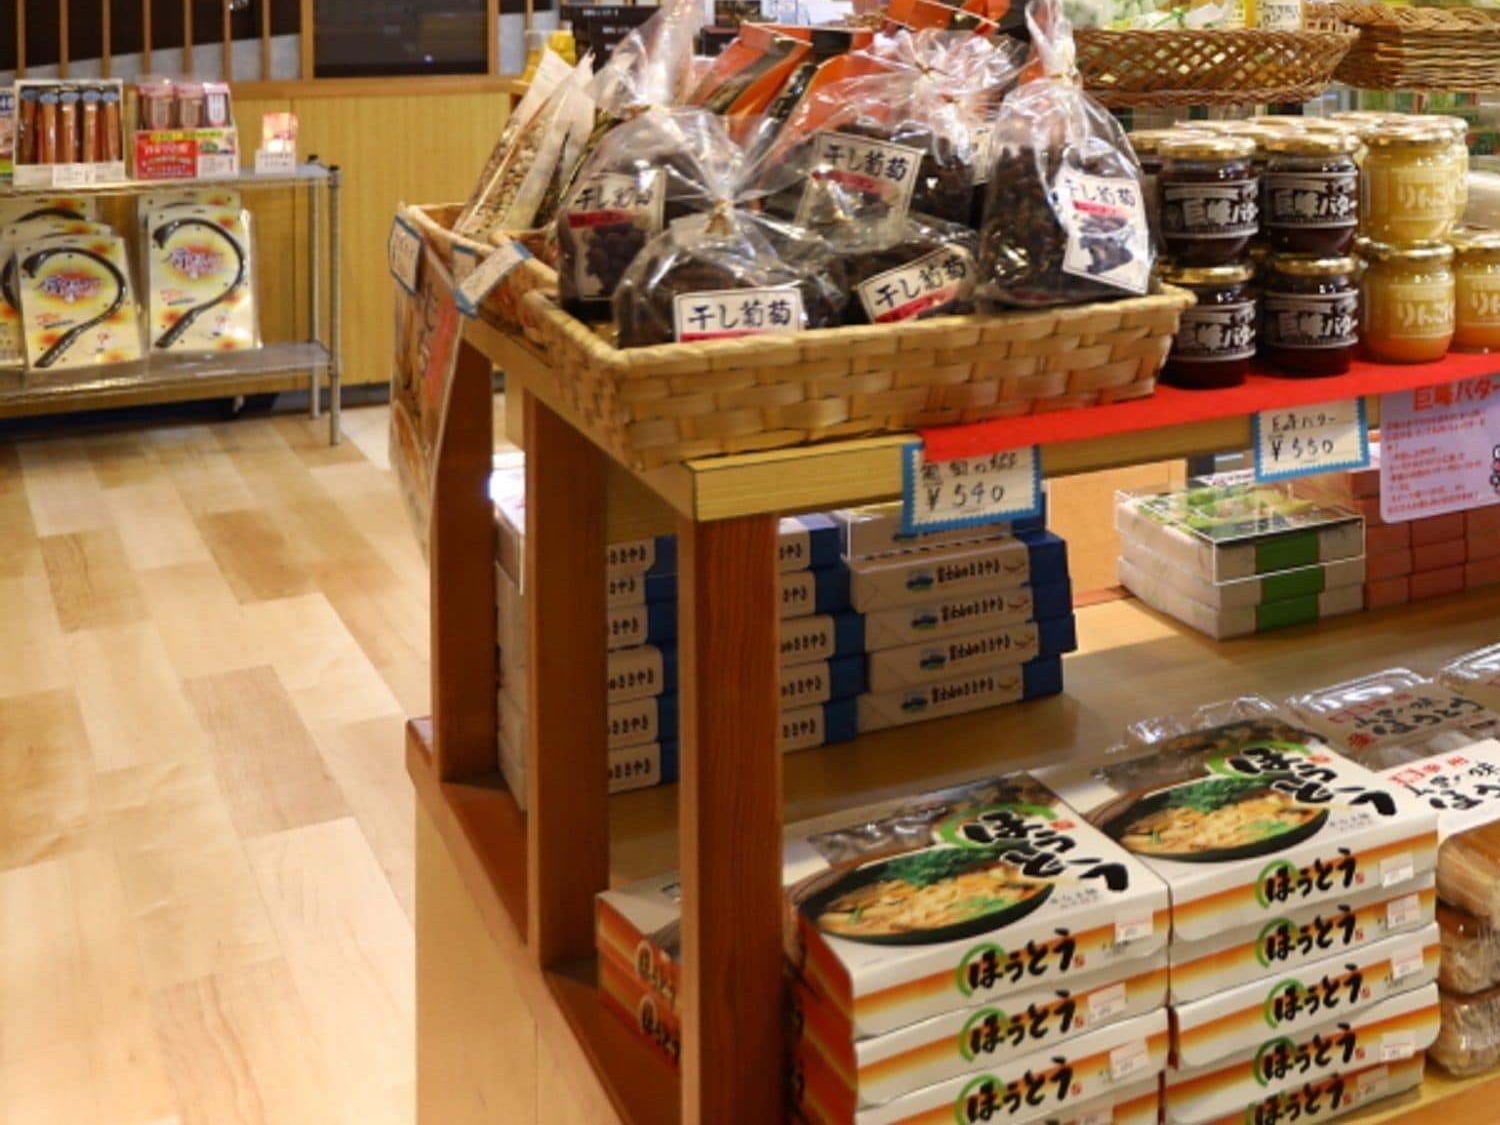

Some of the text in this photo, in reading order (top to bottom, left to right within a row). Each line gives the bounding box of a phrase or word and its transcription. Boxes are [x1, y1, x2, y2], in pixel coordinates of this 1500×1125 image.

[826, 144, 908, 182] 干し葡萄
[875, 257, 967, 309] 干し葡萄
[688, 299, 792, 332] 干し葡萄
[927, 480, 1005, 511] ¥540
[1228, 746, 1397, 817] ほうとう
[963, 810, 1130, 893] ほうとう
[1264, 847, 1357, 903] ほうとう
[968, 927, 1076, 991] ほうとう
[1264, 904, 1356, 962] ほうとう
[969, 988, 1076, 1055] ほうとう
[1273, 962, 1364, 1023] ほうとう
[1262, 1022, 1357, 1082] ほうとう
[965, 1055, 1074, 1125] ほうとう
[1254, 1072, 1345, 1125] ほうとう
